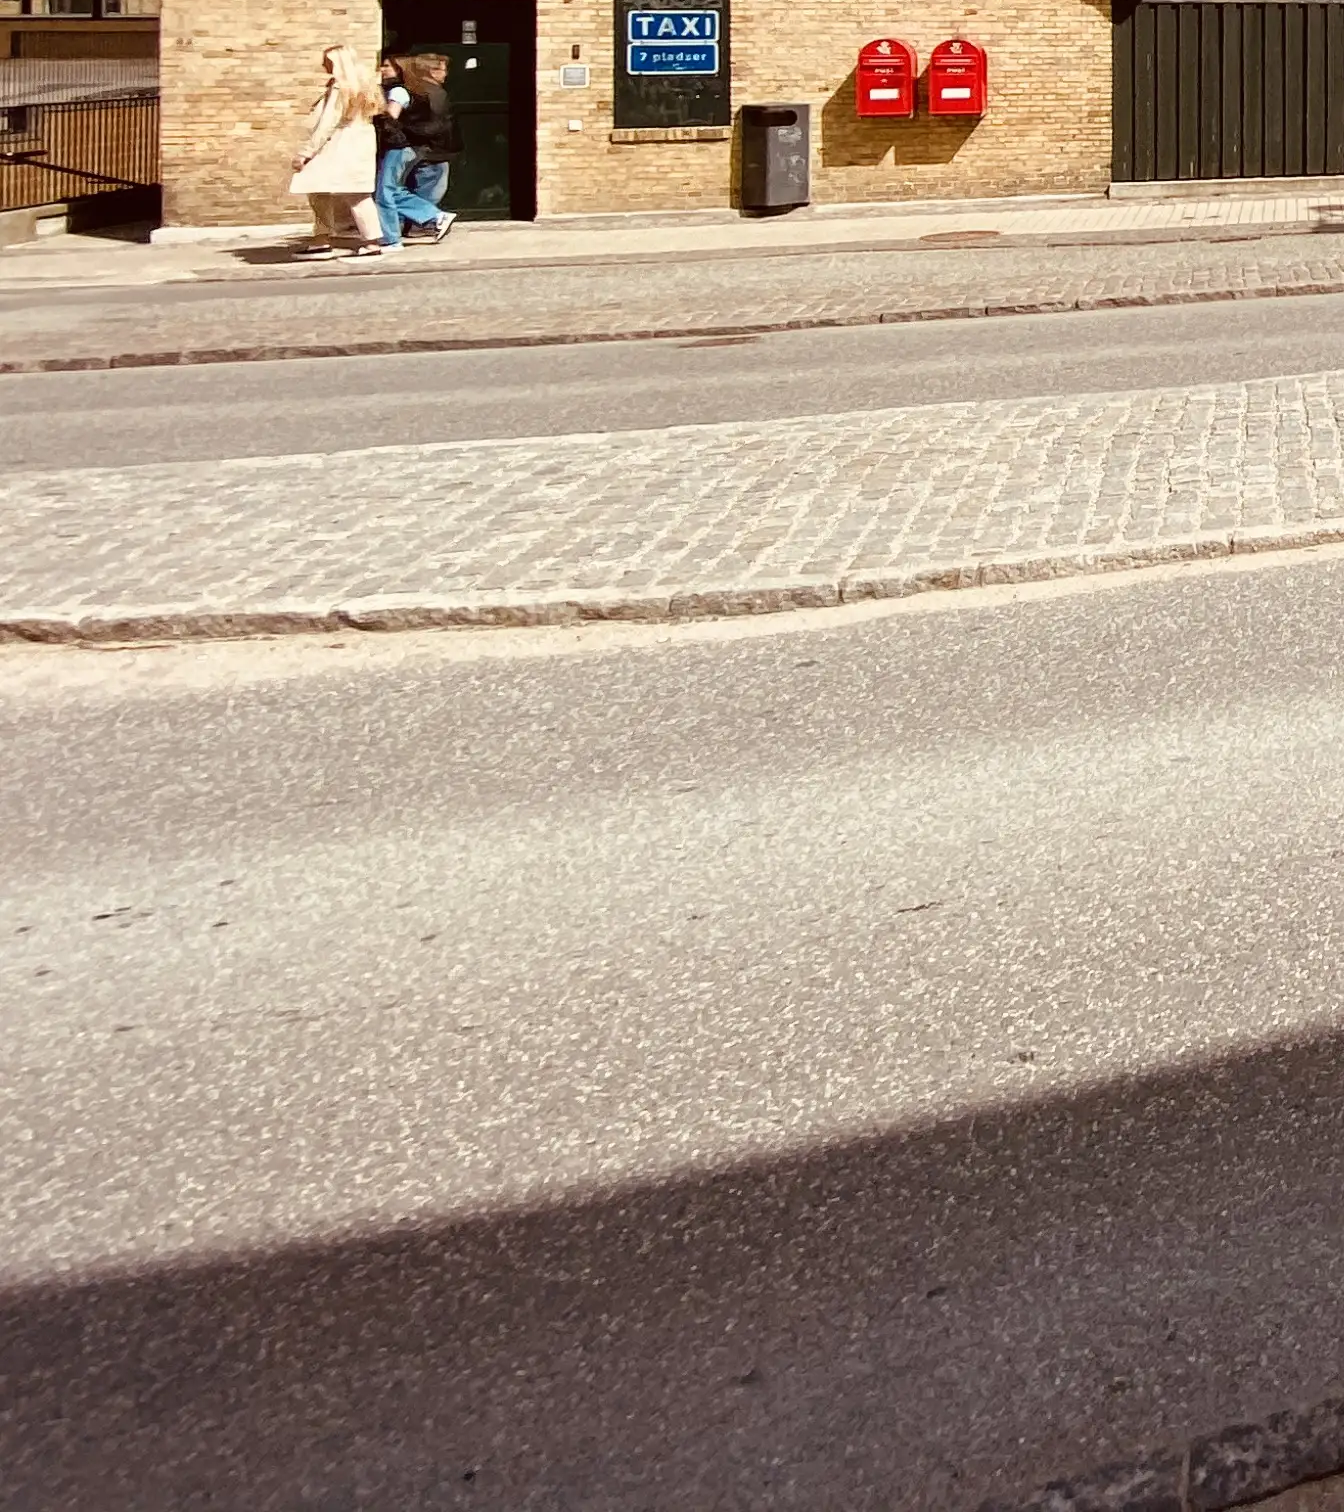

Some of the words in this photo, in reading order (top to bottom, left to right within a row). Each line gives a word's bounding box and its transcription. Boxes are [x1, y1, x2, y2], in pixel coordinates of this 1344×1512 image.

[635, 16, 712, 37] TAXI
[639, 51, 648, 62] 7
[652, 51, 707, 63] pladser
